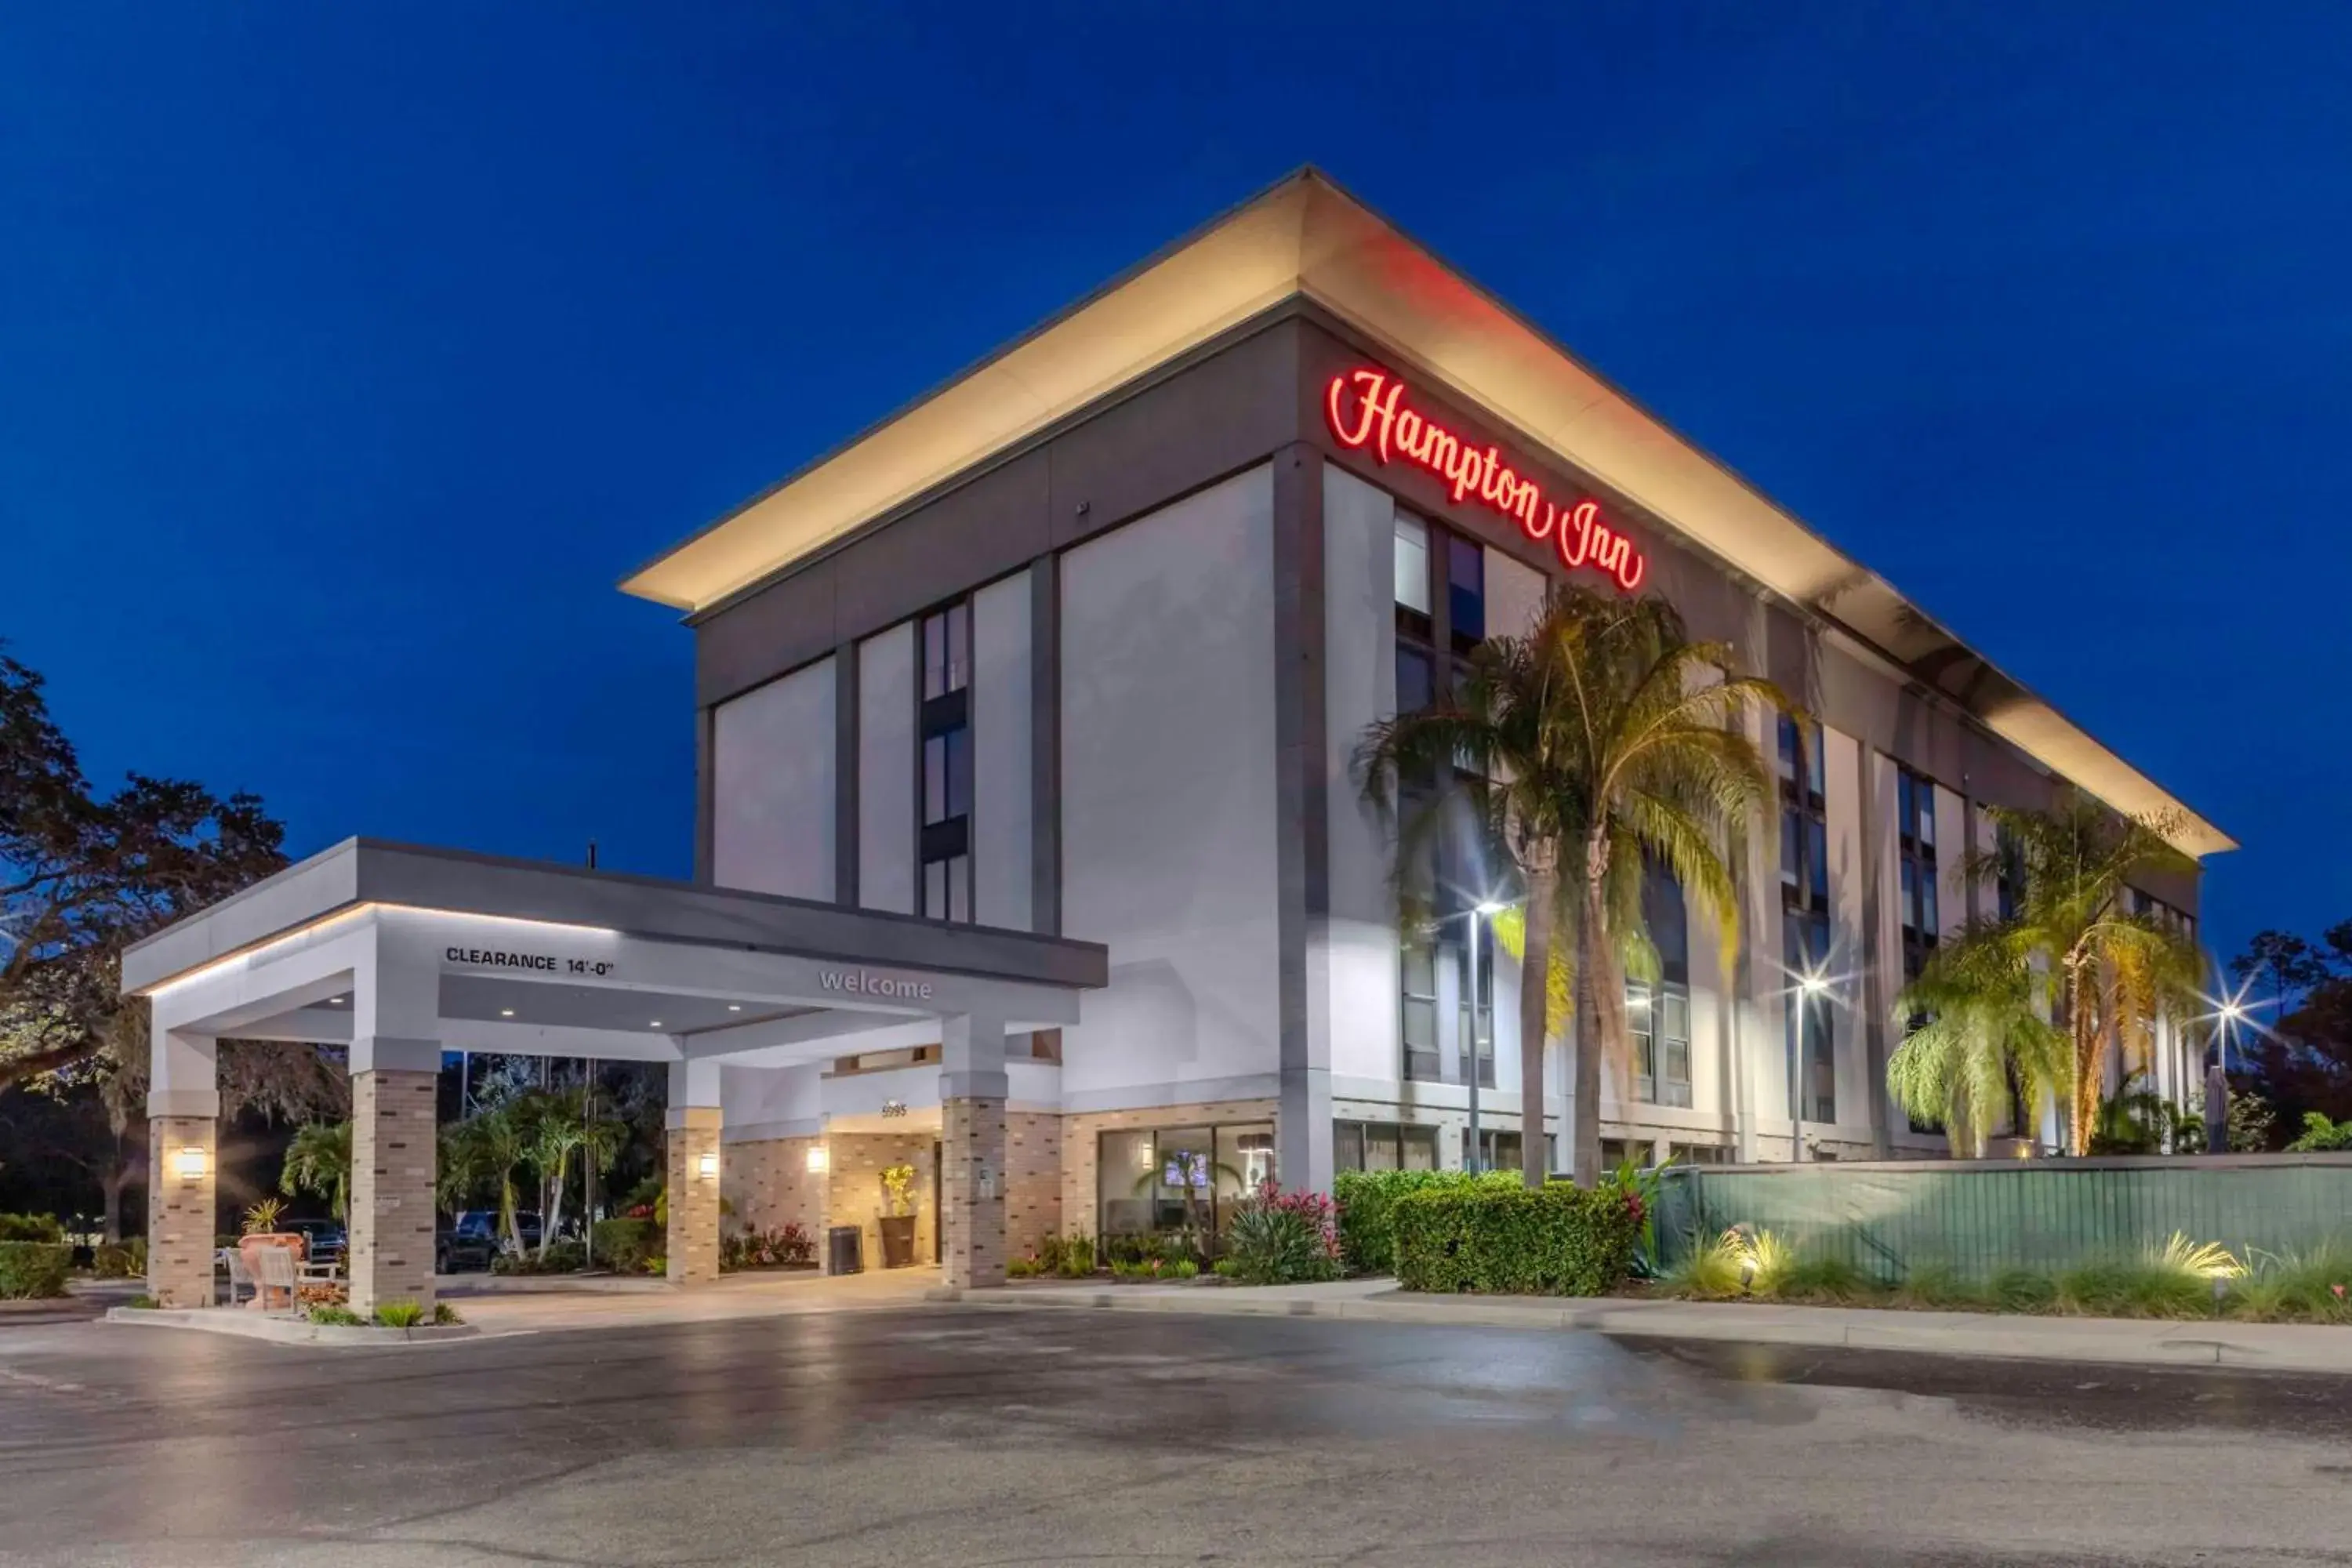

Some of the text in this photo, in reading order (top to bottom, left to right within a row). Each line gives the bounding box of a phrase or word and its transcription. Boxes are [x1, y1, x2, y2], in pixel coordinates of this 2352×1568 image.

[1329, 369, 1643, 590] Hampton Inn
[445, 946, 557, 971] CLEARANCE
[818, 969, 932, 1000] welcome
